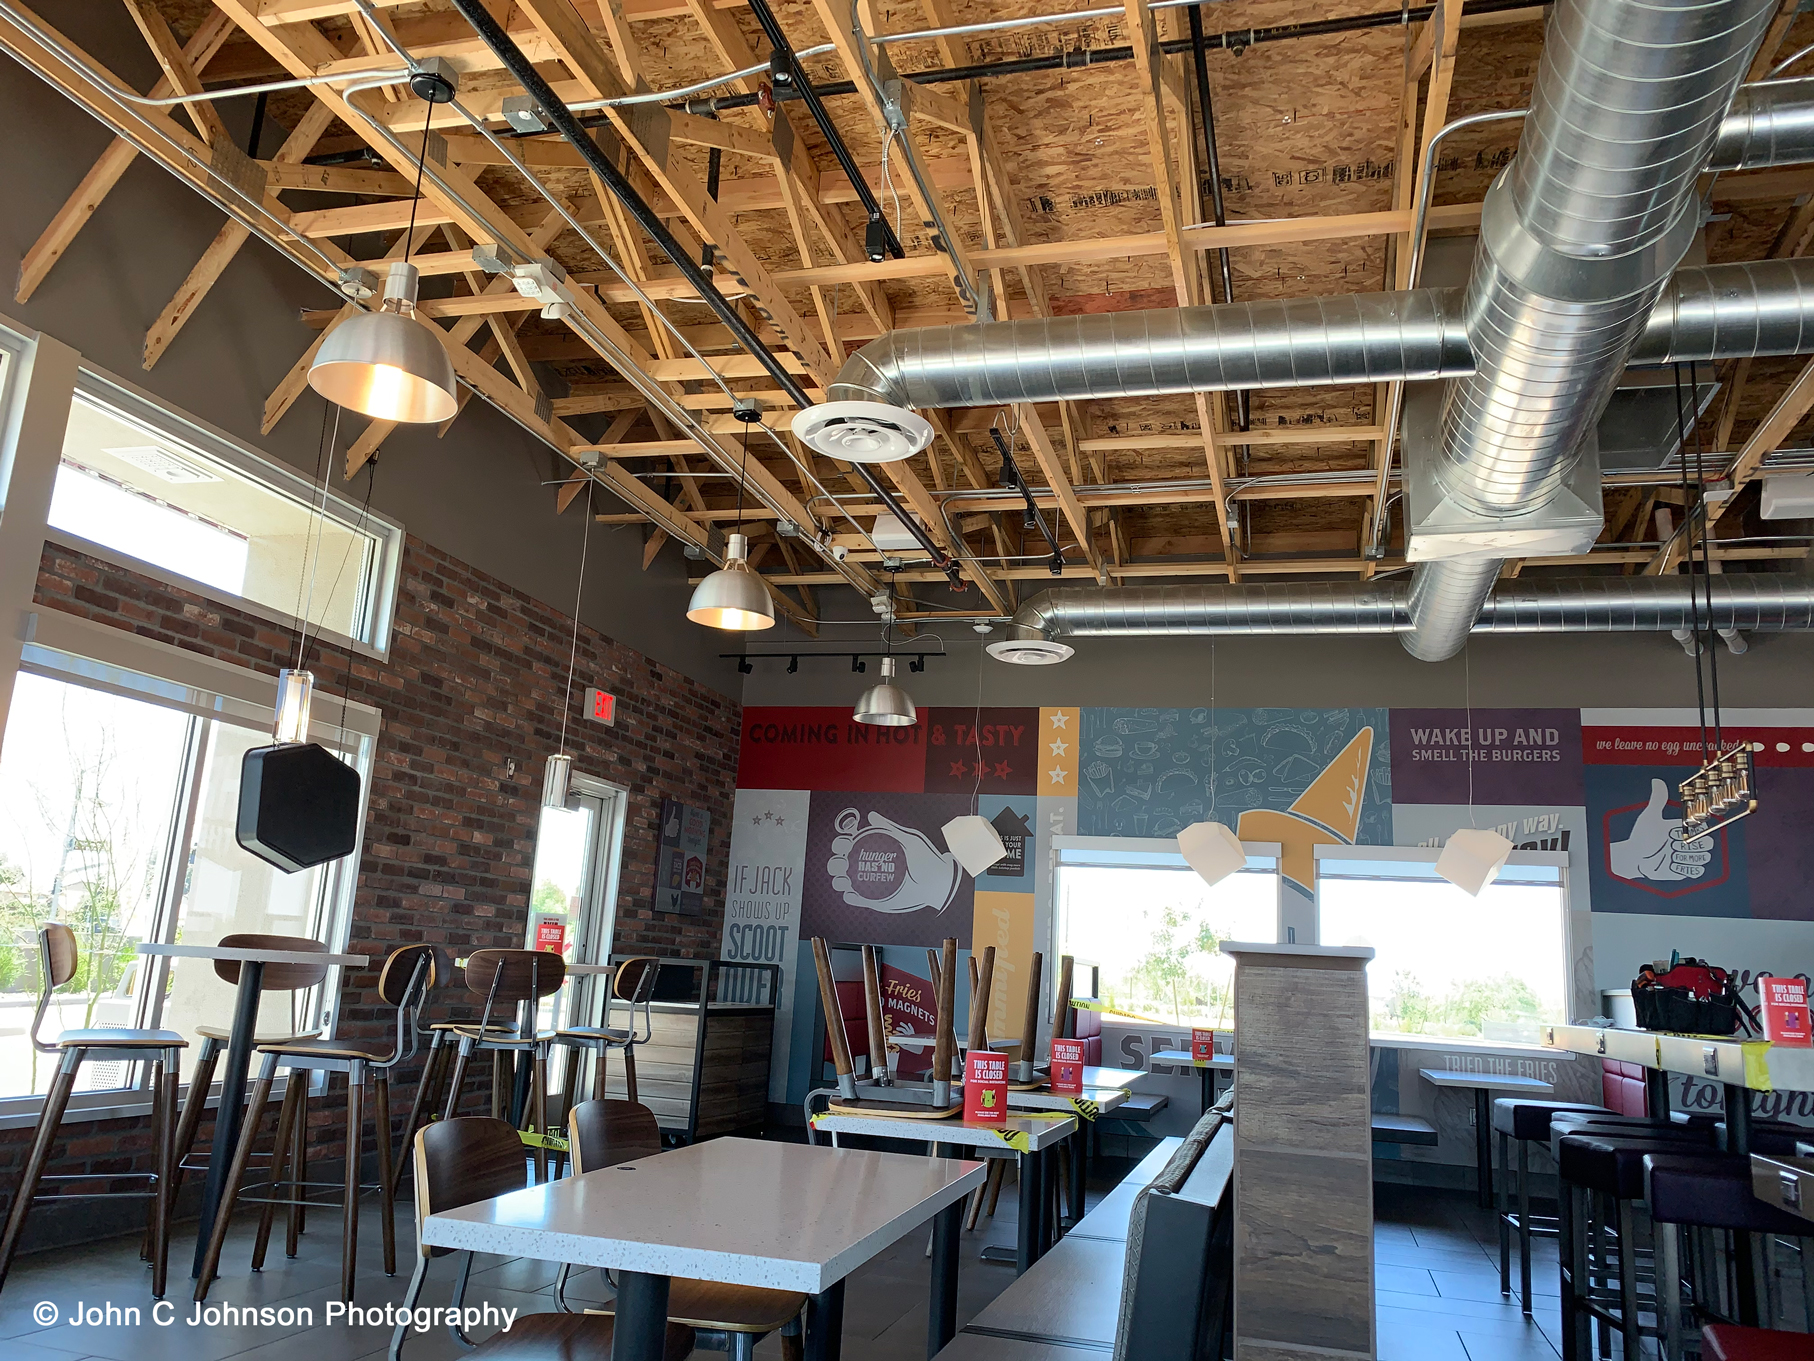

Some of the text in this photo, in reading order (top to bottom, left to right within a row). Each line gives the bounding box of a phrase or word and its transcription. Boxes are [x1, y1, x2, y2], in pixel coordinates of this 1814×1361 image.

[749, 723, 1025, 747] COMING IN HOT & TASTY
[1410, 728, 1559, 745] WAKE UP AND
[1596, 740, 1612, 750] we
[1614, 738, 1643, 750] leave
[1645, 741, 1659, 751] no
[1661, 741, 1681, 756] egg
[1412, 750, 1561, 762] SMELL THE BURGERS
[1523, 813, 1564, 835] way.
[1681, 841, 1705, 851] RISE
[859, 849, 897, 866] hunger
[858, 862, 895, 872] HAS NO
[1676, 865, 1700, 875] FRIES
[733, 865, 792, 896] IF JACK
[857, 872, 895, 882] CURFEW
[731, 900, 790, 920] SHOWS UP
[727, 923, 789, 962] SCOOT
[1771, 984, 1805, 994] THIS TABLE
[1775, 993, 1804, 1003] IS CLOSED
[888, 998, 935, 1026] MAGNETS
[1054, 1044, 1081, 1053] THIS TABLE
[1055, 1051, 1079, 1060] IS CLOSED
[973, 1060, 1005, 1070] THIS TABLE
[1443, 1055, 1557, 1084] TRIED THE FRIES
[975, 1069, 1003, 1080] IS CLOSED
